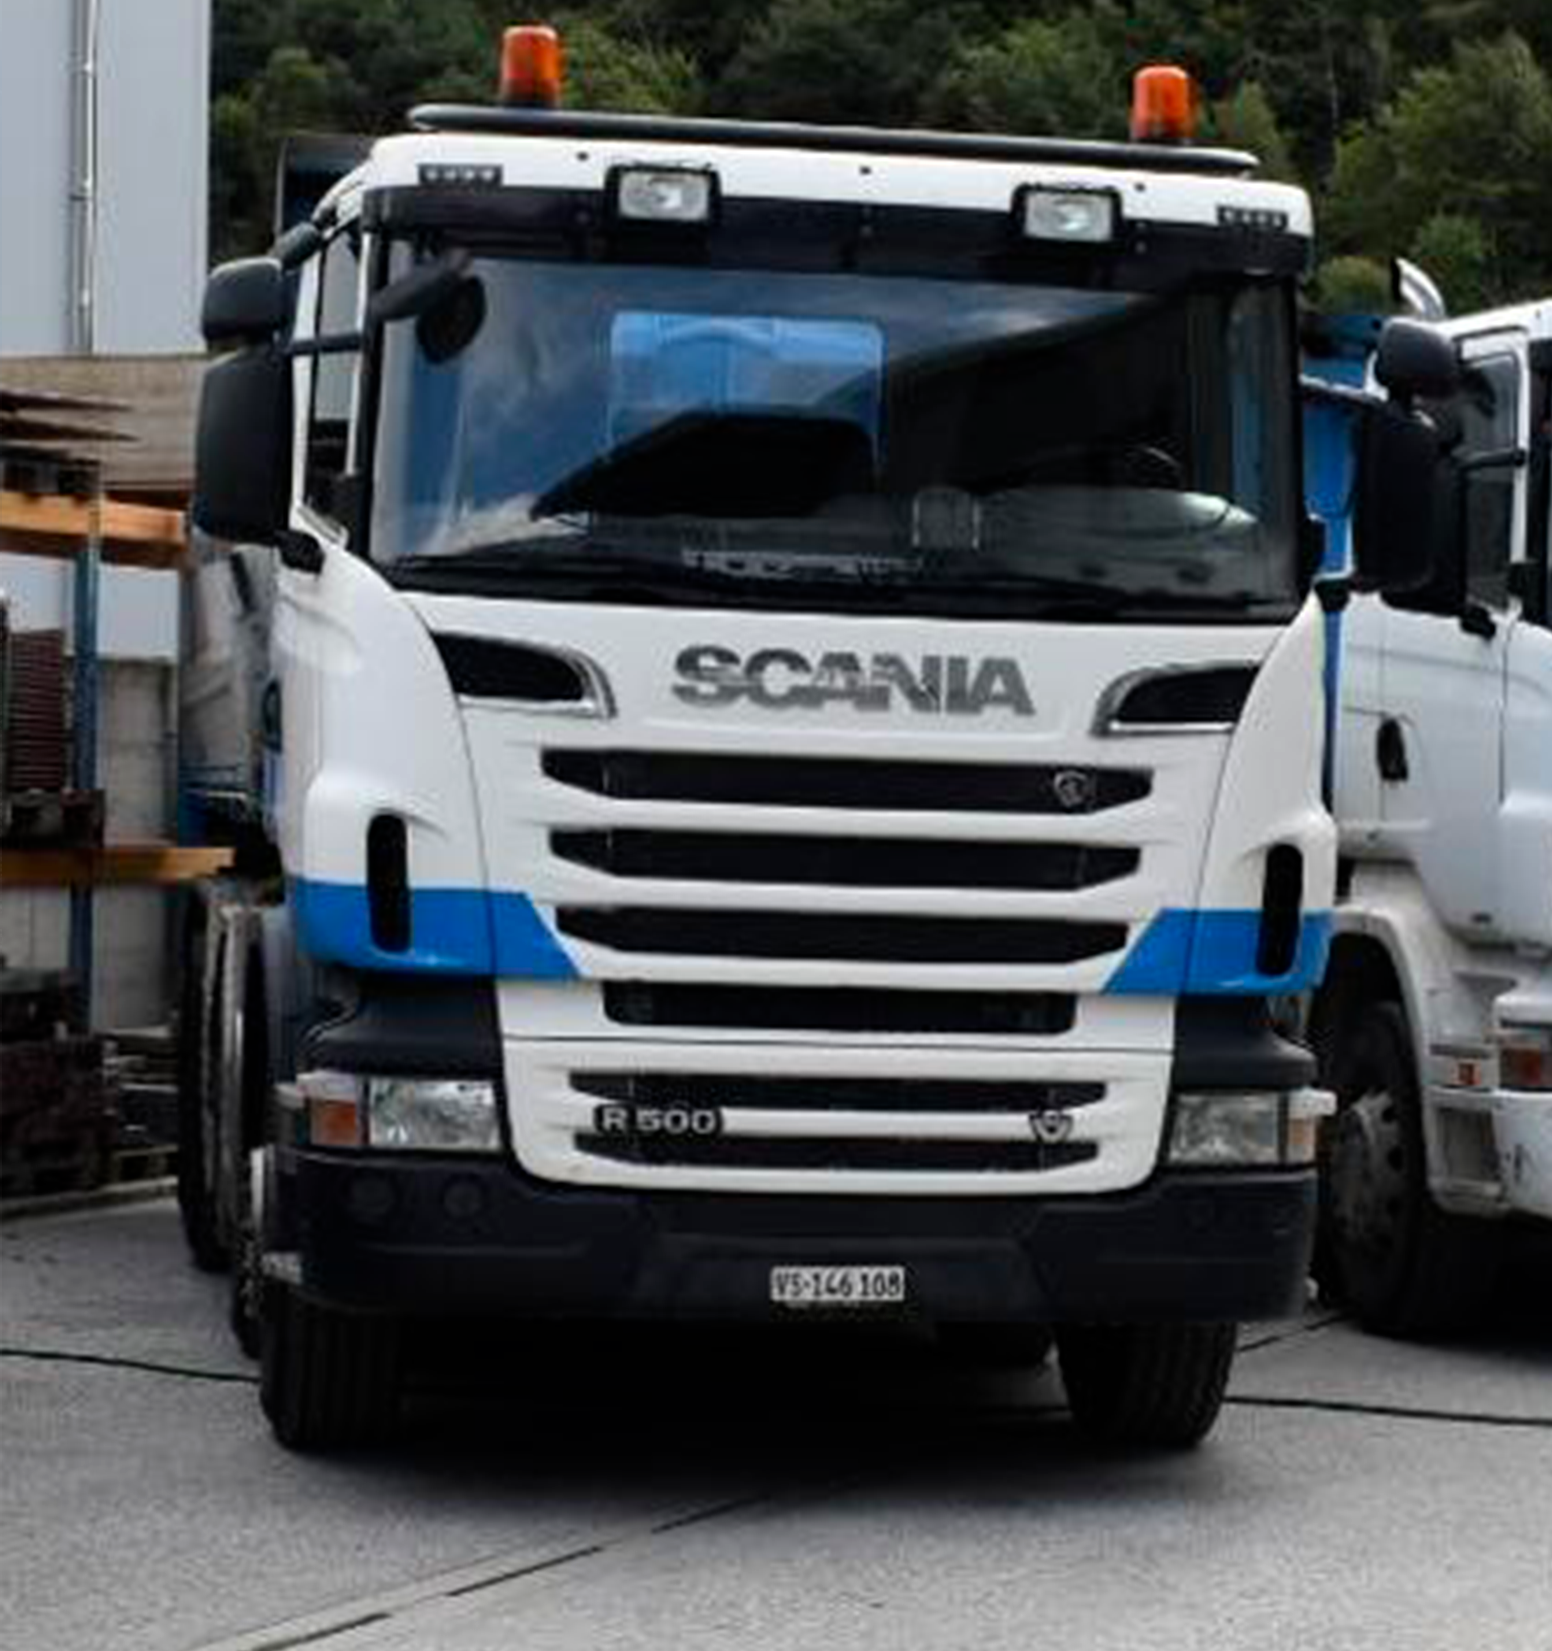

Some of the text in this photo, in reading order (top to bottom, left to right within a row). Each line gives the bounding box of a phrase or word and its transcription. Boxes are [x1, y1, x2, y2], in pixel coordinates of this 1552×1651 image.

[671, 644, 1036, 716] SCANIA
[601, 1106, 716, 1135] R 500
[861, 1272, 901, 1298] 108
